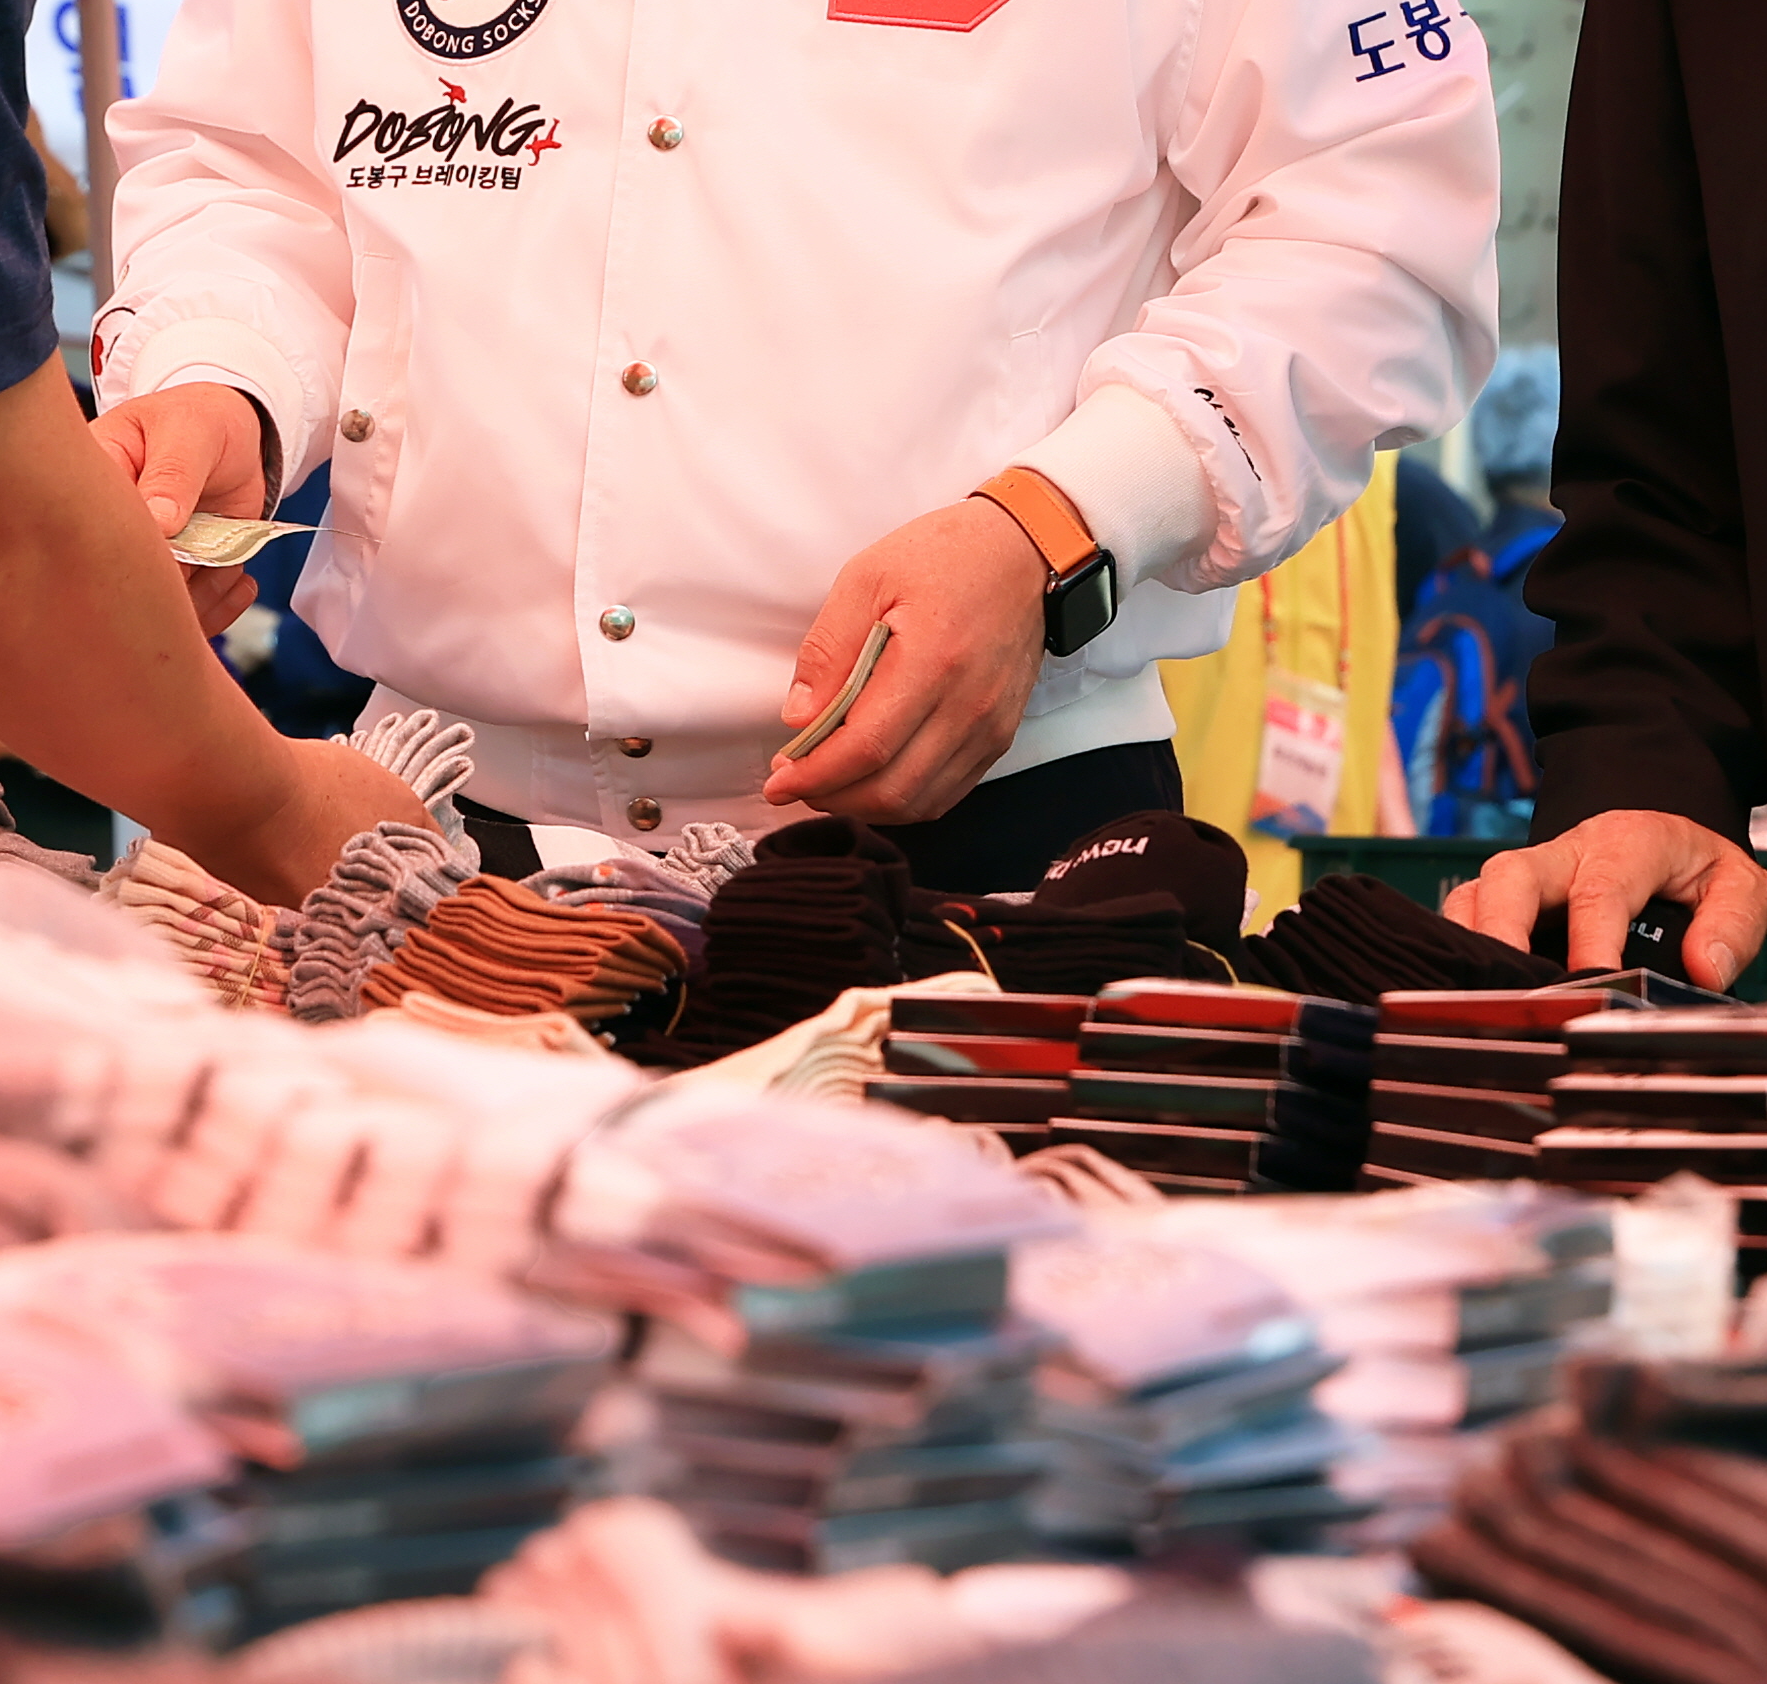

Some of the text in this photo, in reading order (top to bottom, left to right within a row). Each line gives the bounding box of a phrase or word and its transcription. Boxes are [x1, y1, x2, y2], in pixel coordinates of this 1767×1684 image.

[404, 1, 475, 53] DOBONG
[333, 97, 546, 163] DOBONG
[346, 164, 522, 190] 도봉구 브레이킹팀
